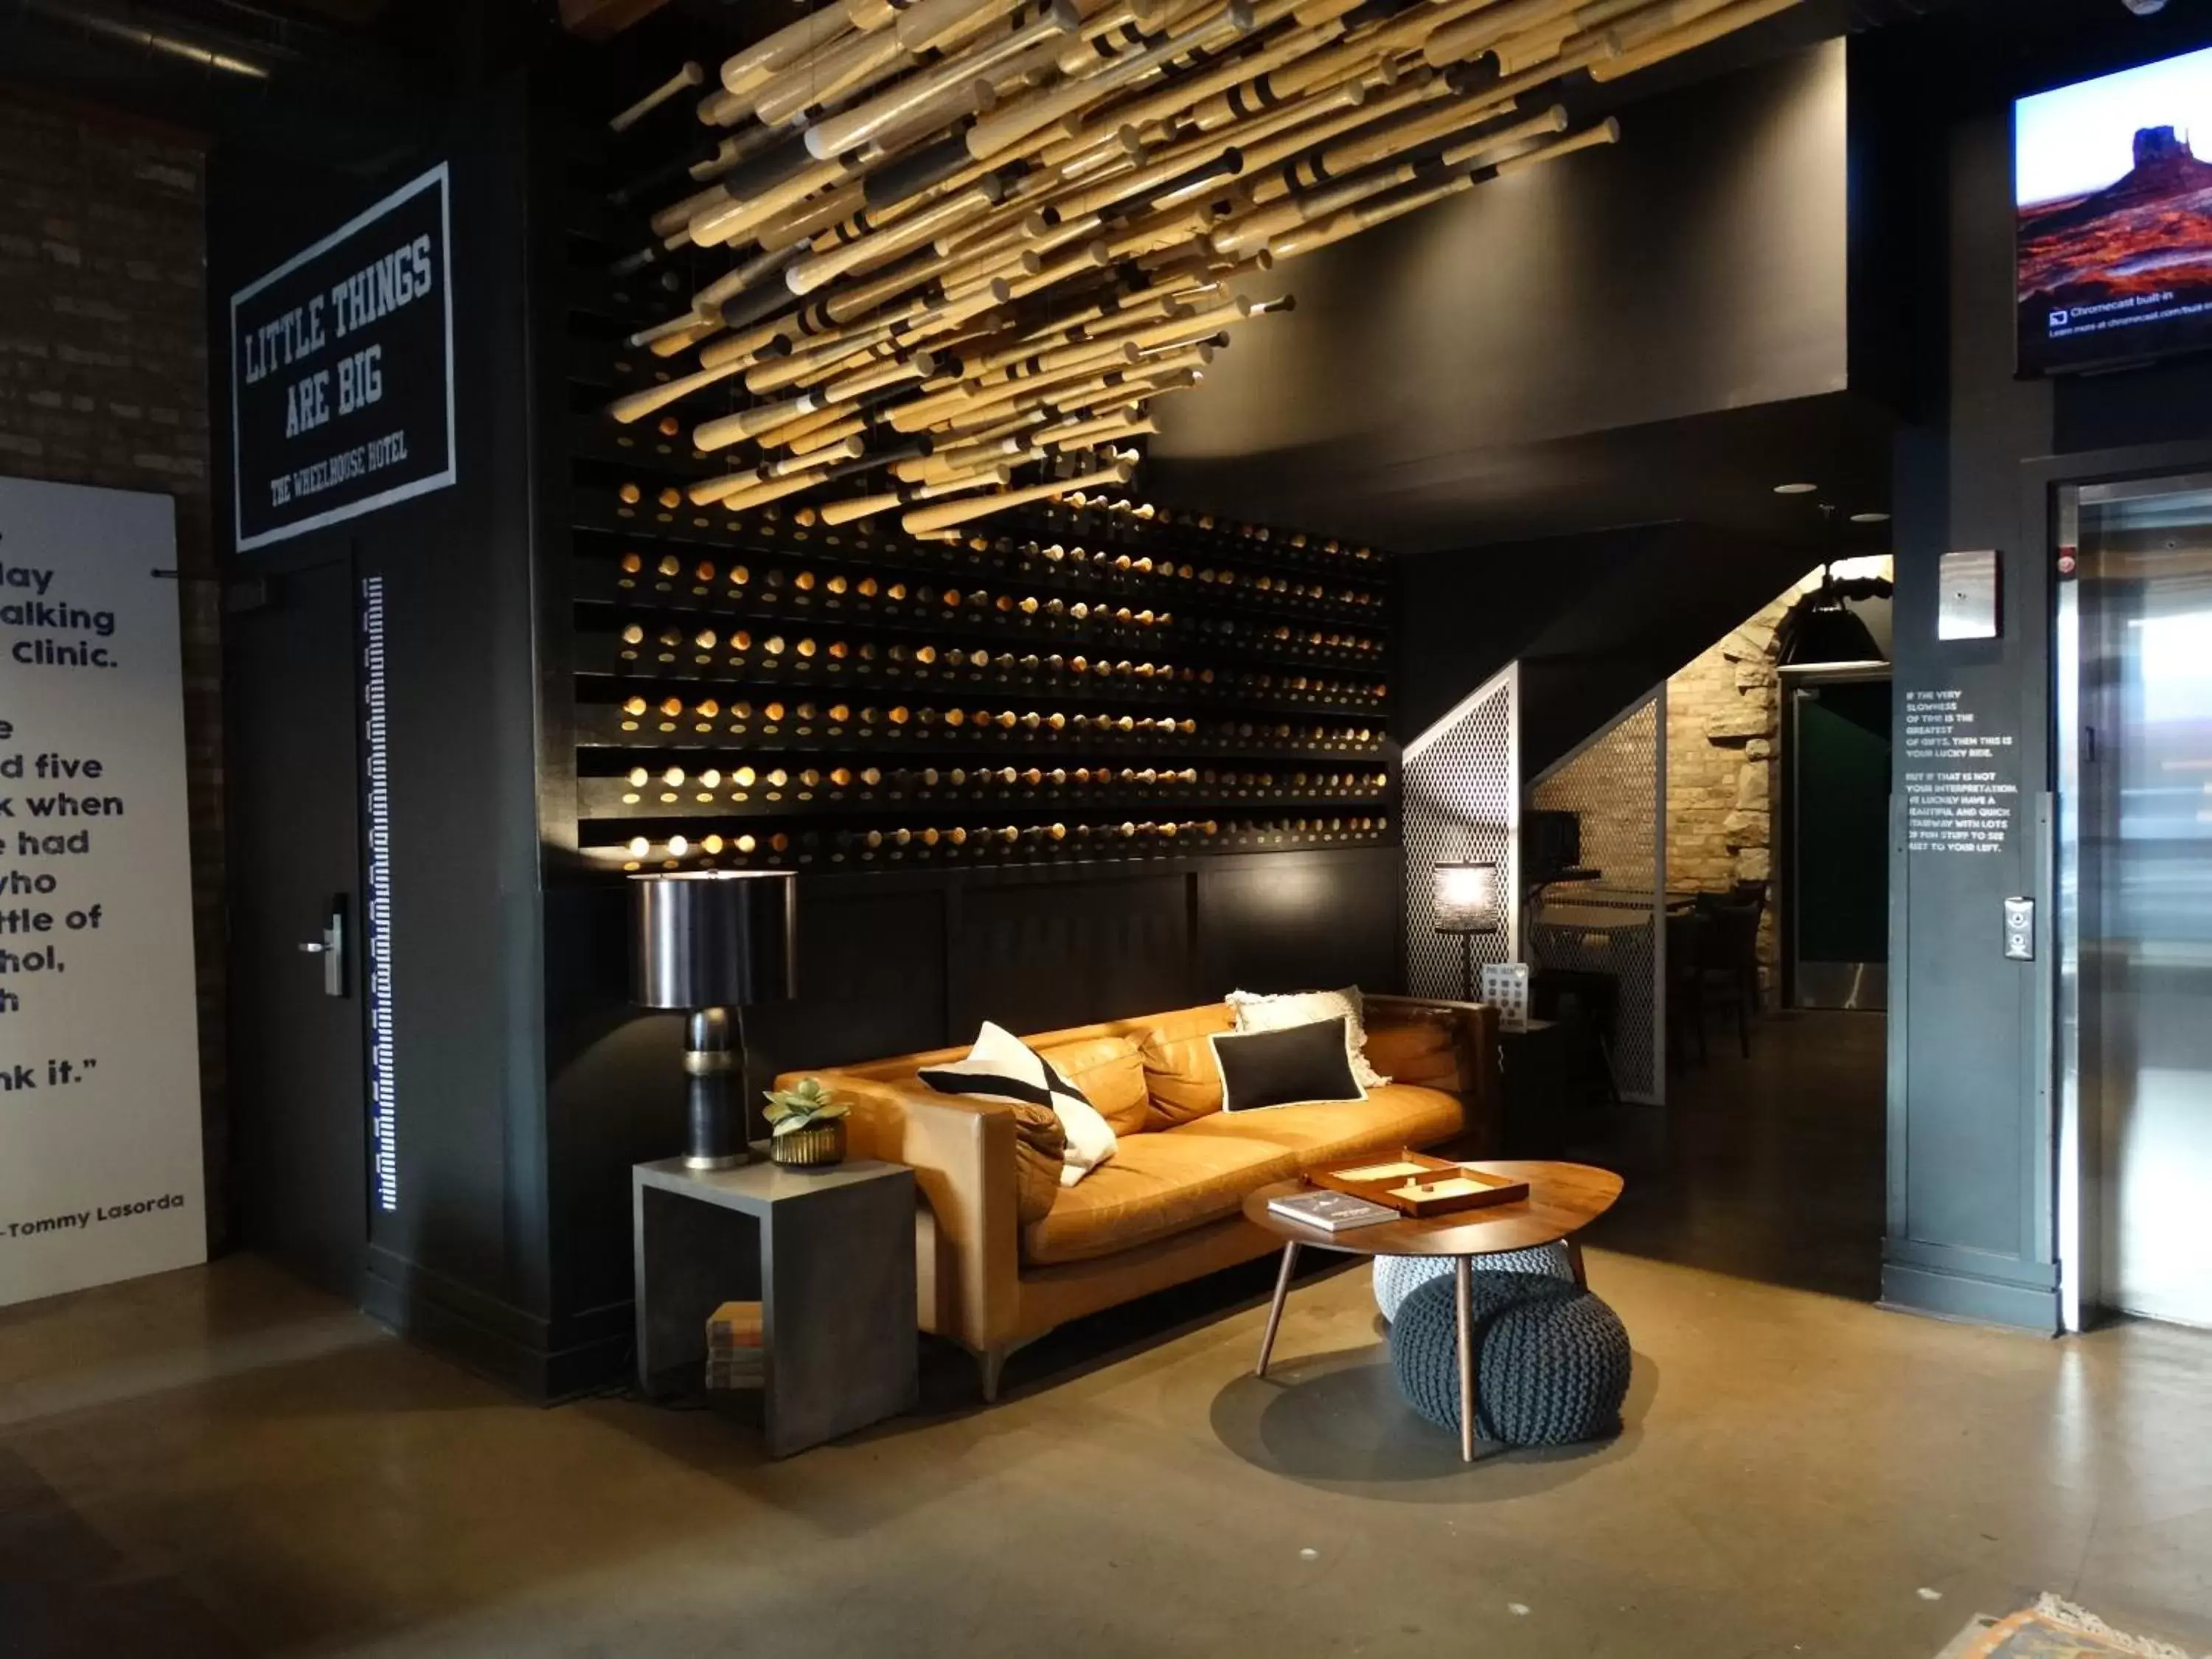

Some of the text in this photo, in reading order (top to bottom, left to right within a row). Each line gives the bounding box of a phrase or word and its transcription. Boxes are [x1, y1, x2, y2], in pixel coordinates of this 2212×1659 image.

[245, 233, 432, 383] LITTLE THINGS
[2070, 297, 2135, 317] Chromecast
[2073, 323, 2096, 333] more
[2097, 321, 2107, 330] at
[285, 344, 383, 439] ARE BIG
[270, 430, 408, 507] THE WHEELHOUSE HOTEL
[12, 639, 118, 668] Clinic.
[1906, 690, 1962, 700] IF THE VERY
[1906, 702, 1958, 712] SLOWNESS
[1906, 714, 1920, 723] OF
[1944, 714, 1955, 723] IS
[1955, 713, 1975, 723] THE
[1905, 726, 1953, 735] GREATEST
[1905, 737, 1919, 746] OF
[1952, 736, 1978, 746] THEN
[1980, 736, 2001, 745] THIS
[2002, 736, 2013, 745] IS
[1905, 749, 1933, 758] YOUR
[1935, 748, 1967, 758] LUCKY
[35, 752, 104, 779] five
[1905, 772, 1924, 782] BUT
[1936, 772, 1961, 782] THAT
[1962, 772, 1972, 782] IS
[1974, 772, 1997, 782] NOT
[1905, 784, 1933, 793] YOUR
[26, 792, 124, 817] when
[1961, 796, 1986, 805] HAVE
[1987, 796, 1997, 805] A
[1956, 807, 1978, 816] AND
[1978, 807, 2011, 817] QUICK
[1955, 819, 1980, 829] WITH
[1981, 819, 2008, 830] LOTS
[1940, 830, 1969, 840] STUFF
[1970, 831, 1986, 841] TO
[1988, 831, 2005, 841] SEE
[18, 829, 90, 856] had
[1930, 842, 1945, 852] TO
[1947, 842, 1975, 852] YOUR
[65, 903, 102, 930] of
[97, 1193, 184, 1222] Lasorda
